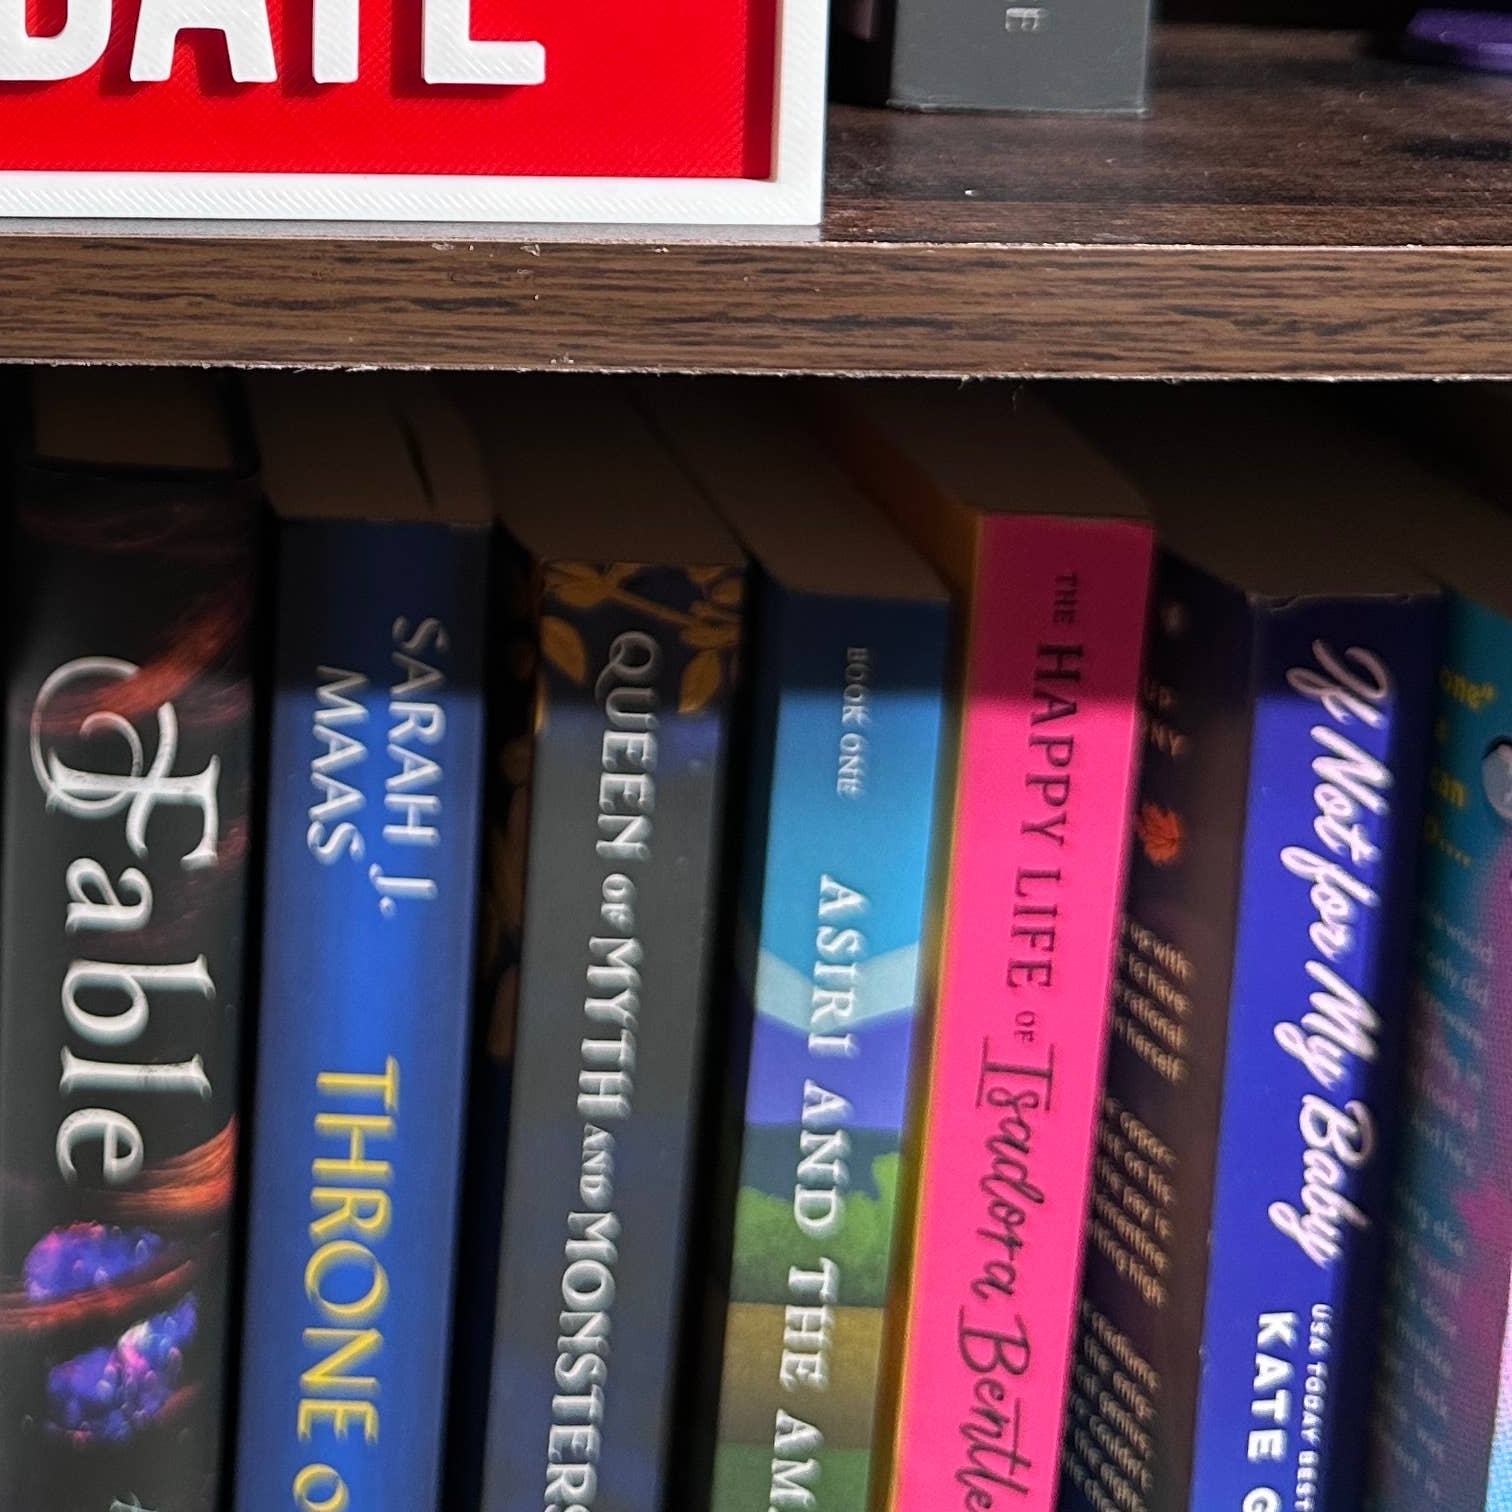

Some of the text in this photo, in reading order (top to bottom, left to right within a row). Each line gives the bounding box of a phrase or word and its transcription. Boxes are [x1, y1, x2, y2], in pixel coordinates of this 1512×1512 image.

[1053, 572, 1079, 625] THE
[306, 666, 371, 864] MAAS
[370, 617, 450, 918] SARAH J.
[595, 631, 660, 862] QUEEN
[837, 646, 873, 799] BOOK ONE
[1021, 642, 1084, 847] HAPPY
[1310, 726, 1394, 868] Not
[30, 656, 221, 1184] Fable
[1006, 866, 1062, 990] LIFE
[1280, 845, 1381, 961] for
[577, 936, 643, 1120] MYTH
[1274, 960, 1382, 1091] My
[297, 1055, 400, 1445] THRONE
[579, 1123, 616, 1209] AND
[769, 873, 870, 1512] ASIRI AND THE AM
[971, 1036, 1055, 1300] Isadora
[1267, 1092, 1378, 1271] Baby
[544, 1211, 621, 1512] MONSTER
[1247, 1311, 1300, 1464] KATE
[1301, 1360, 1329, 1447] TODAY
[1308, 1303, 1335, 1357] USA
